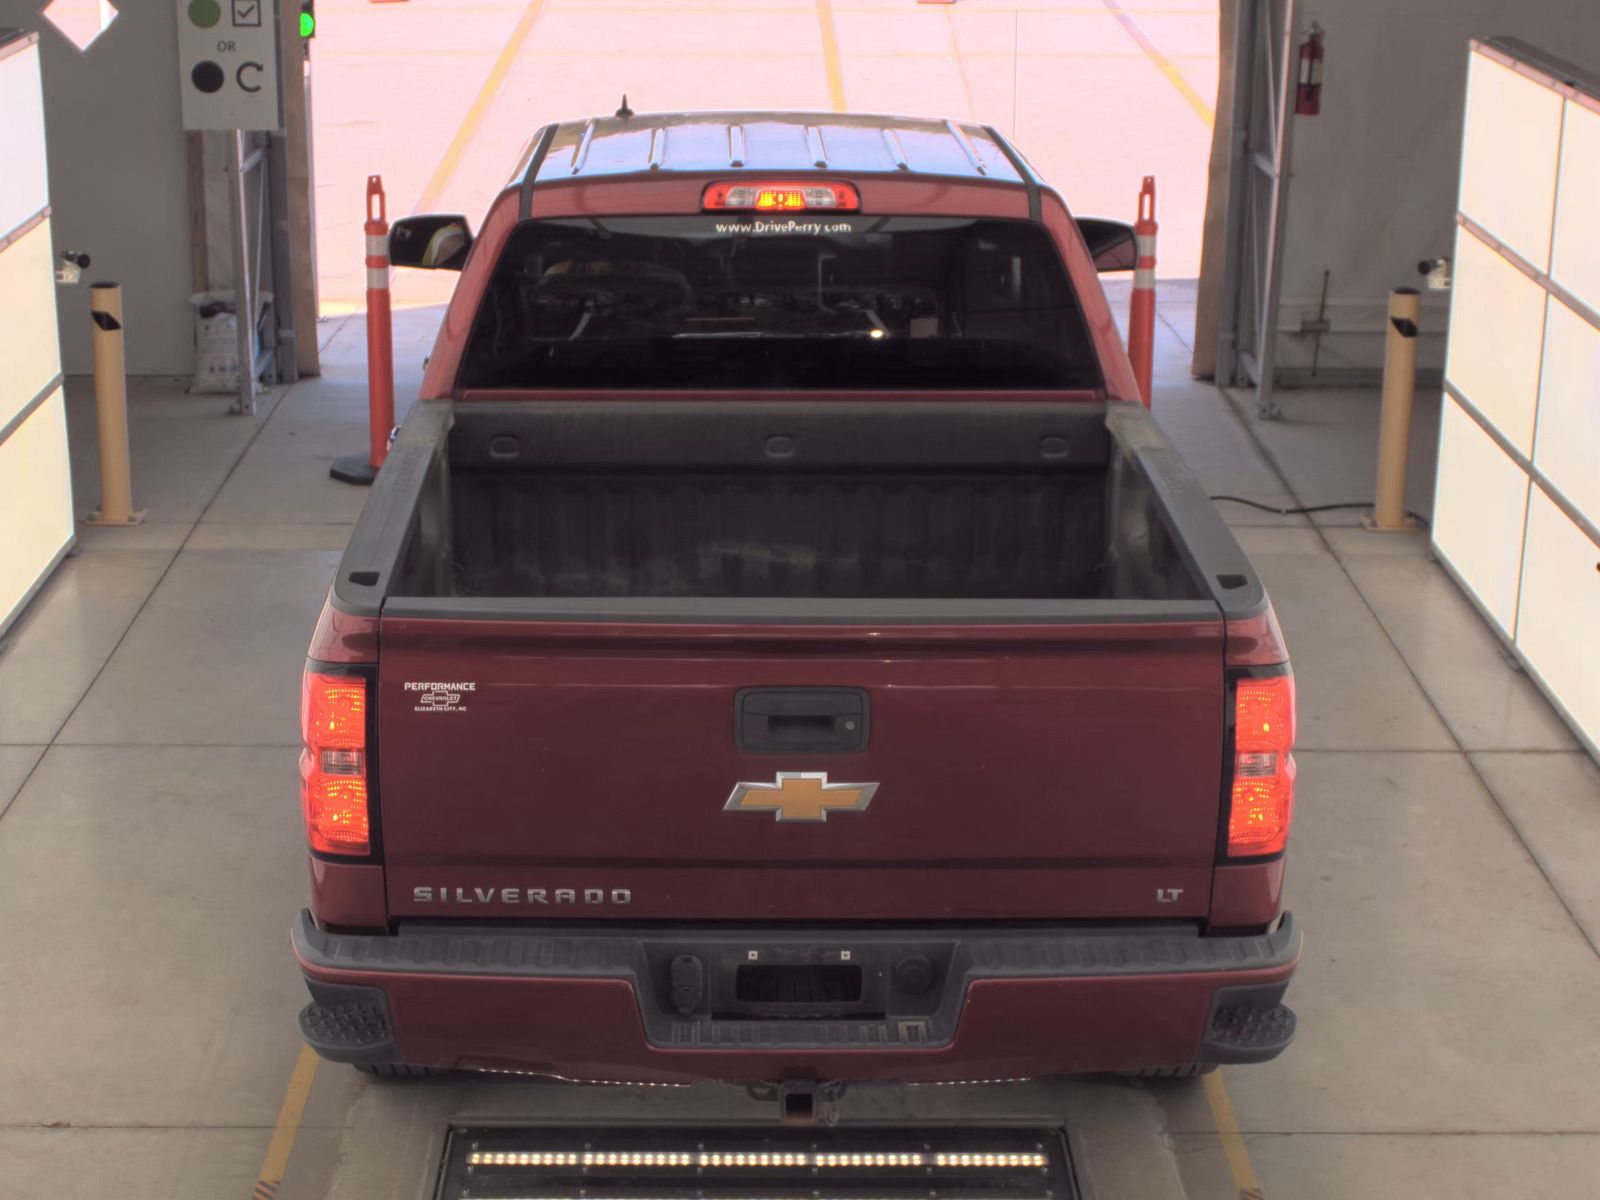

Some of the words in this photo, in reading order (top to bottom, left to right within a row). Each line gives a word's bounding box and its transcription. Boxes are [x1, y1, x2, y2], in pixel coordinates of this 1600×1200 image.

[216, 40, 237, 52] OR
[715, 220, 852, 235] www.DrivePerrycom
[404, 682, 476, 691] PERFORMANCE
[413, 887, 632, 905] SILVERADO
[1156, 888, 1184, 903] LT
